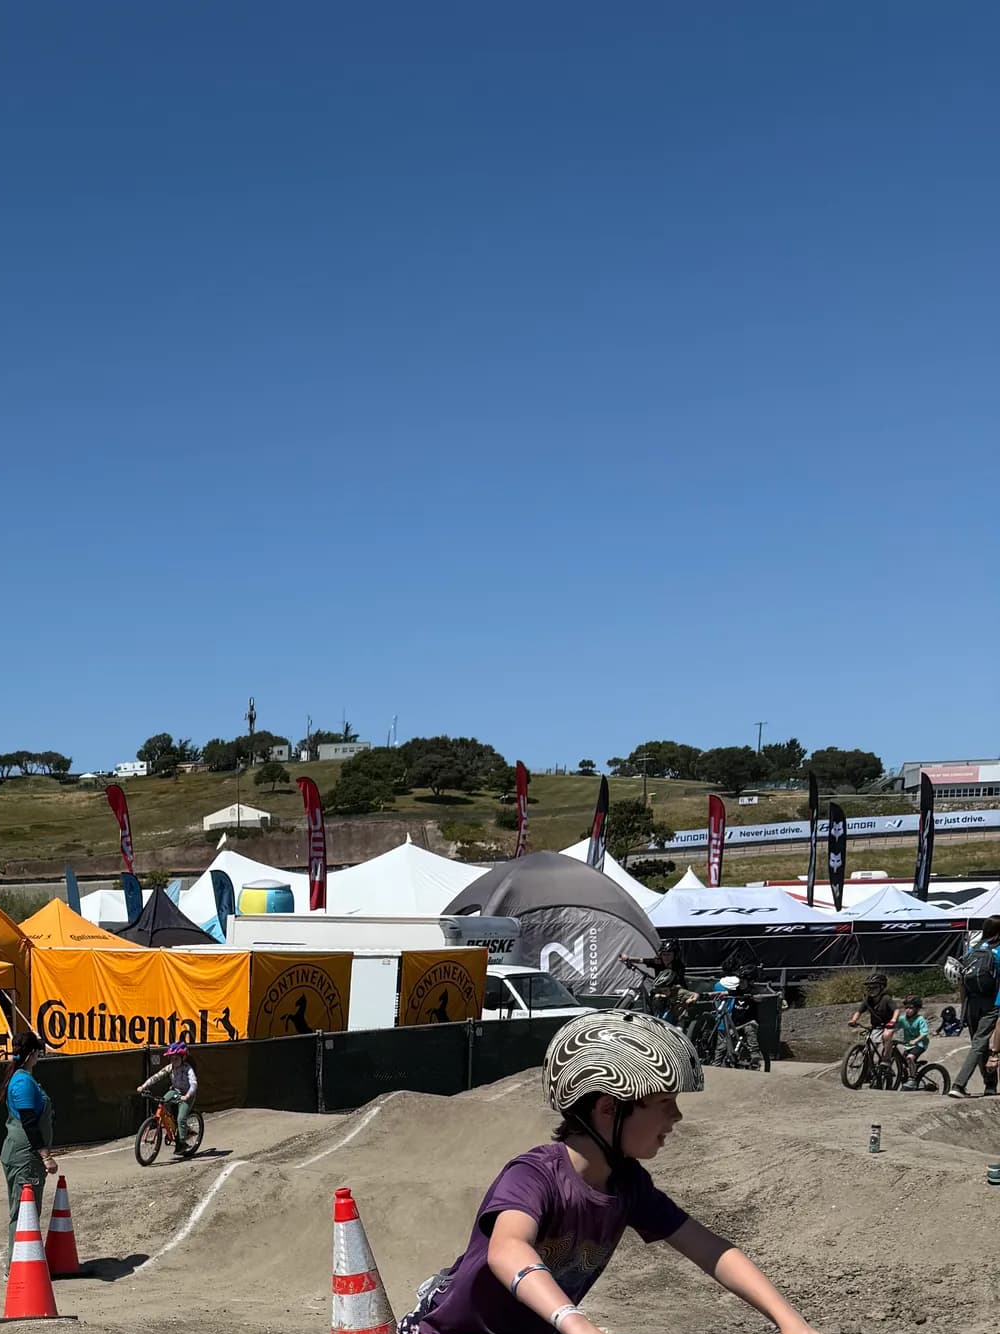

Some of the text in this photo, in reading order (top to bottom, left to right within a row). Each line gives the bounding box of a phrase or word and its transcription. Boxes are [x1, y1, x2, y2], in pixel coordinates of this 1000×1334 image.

[944, 817, 960, 825] just
[847, 822, 876, 830] UNDAI
[764, 828, 779, 837] just
[673, 832, 708, 843] YUNDAI
[690, 907, 778, 916] TRP
[764, 925, 806, 933] TRP
[881, 922, 922, 930] TRP
[589, 928, 598, 994] VERSECOND
[263, 968, 341, 1015] CONTINENTAL
[411, 965, 474, 1010] CONTINENTA
[37, 1000, 208, 1048] Continental
